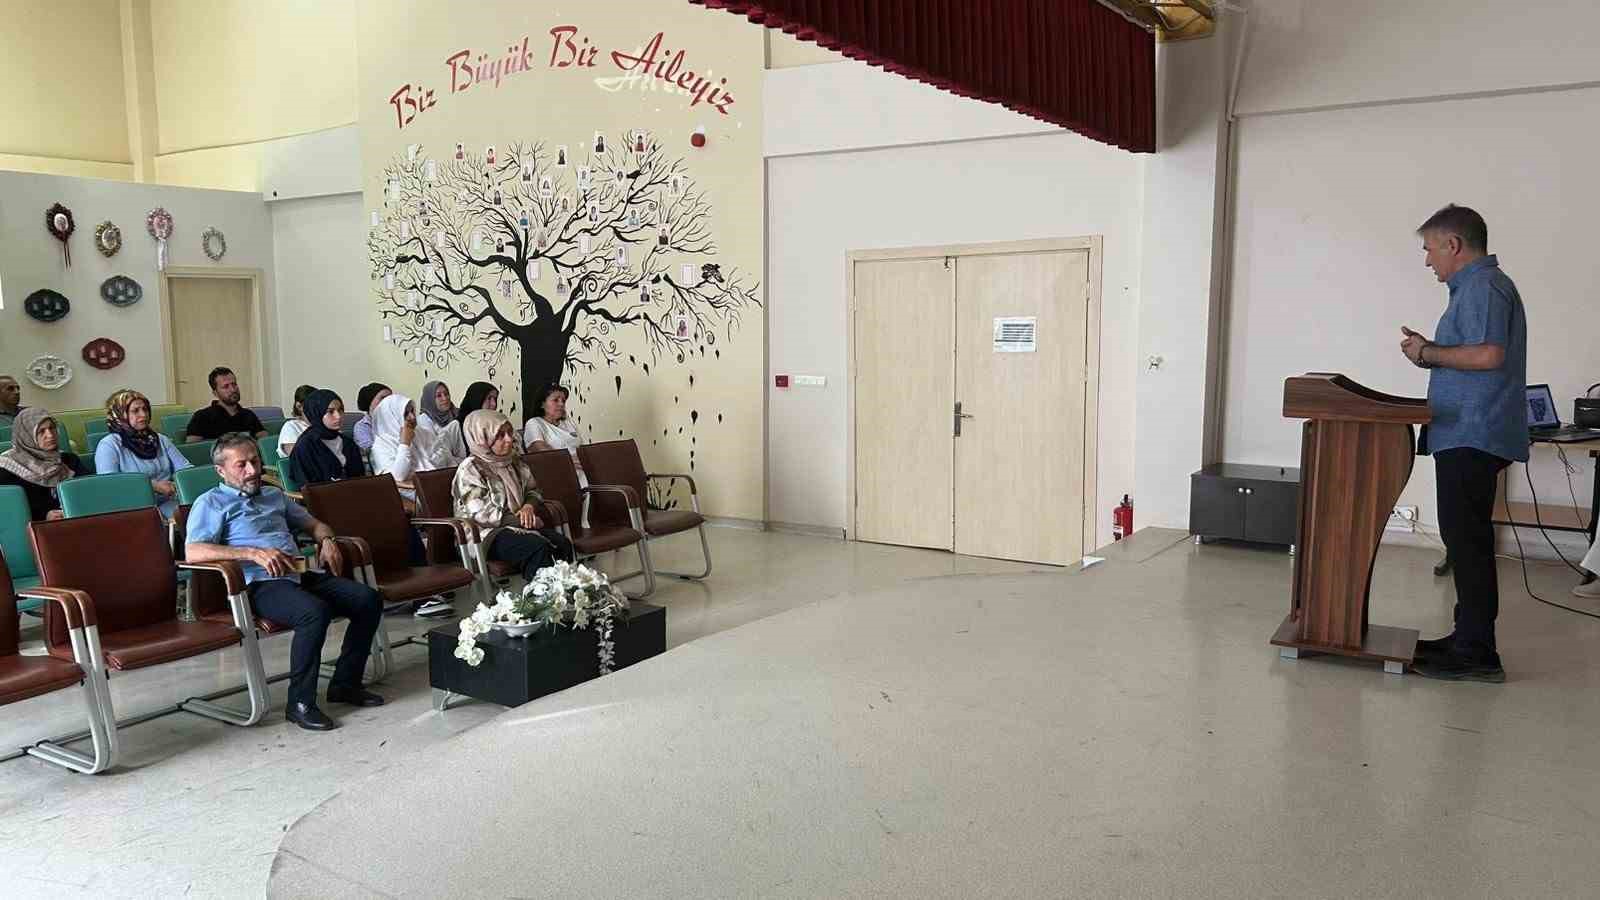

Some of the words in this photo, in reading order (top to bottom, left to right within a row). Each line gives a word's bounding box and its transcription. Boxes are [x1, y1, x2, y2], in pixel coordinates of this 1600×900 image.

[390, 84, 437, 129] Biz
[446, 36, 533, 94] Büyük
[550, 25, 598, 67] Bir
[611, 32, 734, 115] Aileyiz
